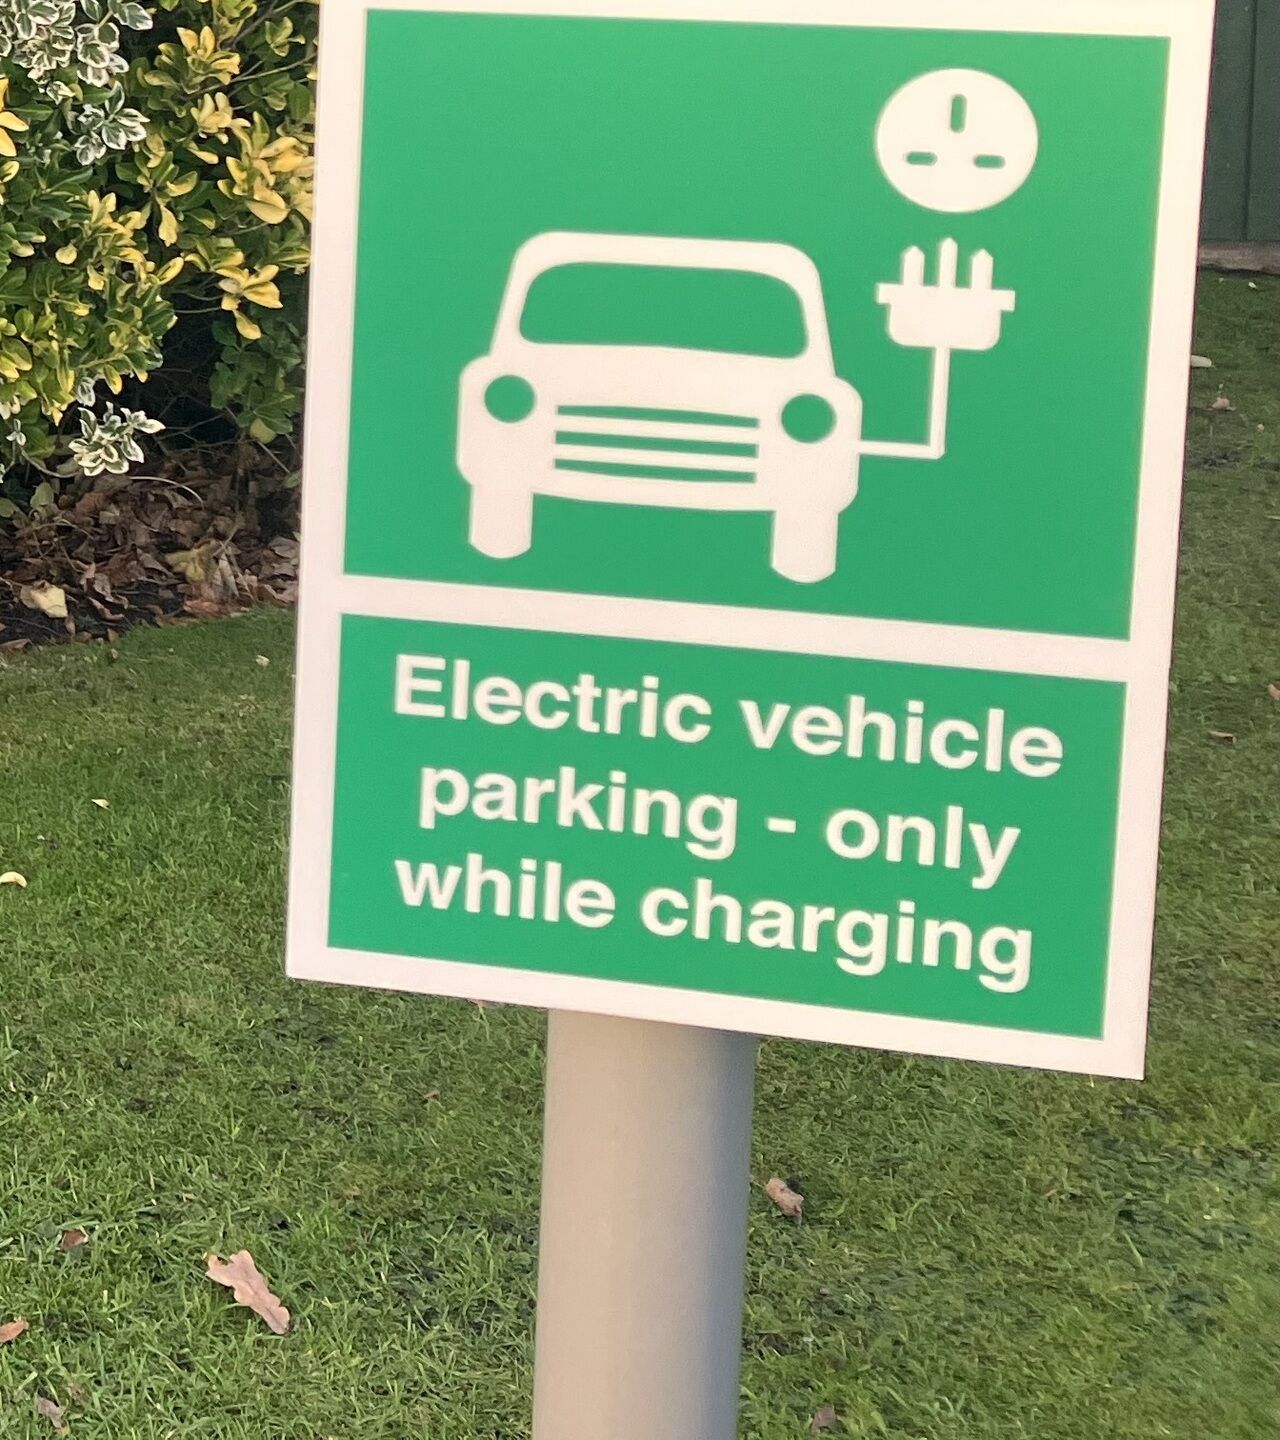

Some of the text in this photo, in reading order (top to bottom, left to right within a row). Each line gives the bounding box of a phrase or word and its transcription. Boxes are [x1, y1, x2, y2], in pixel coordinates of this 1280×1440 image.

[394, 654, 1064, 778] Electric vehicle
[419, 767, 1021, 890] parking - only
[394, 853, 1033, 994] while charging
